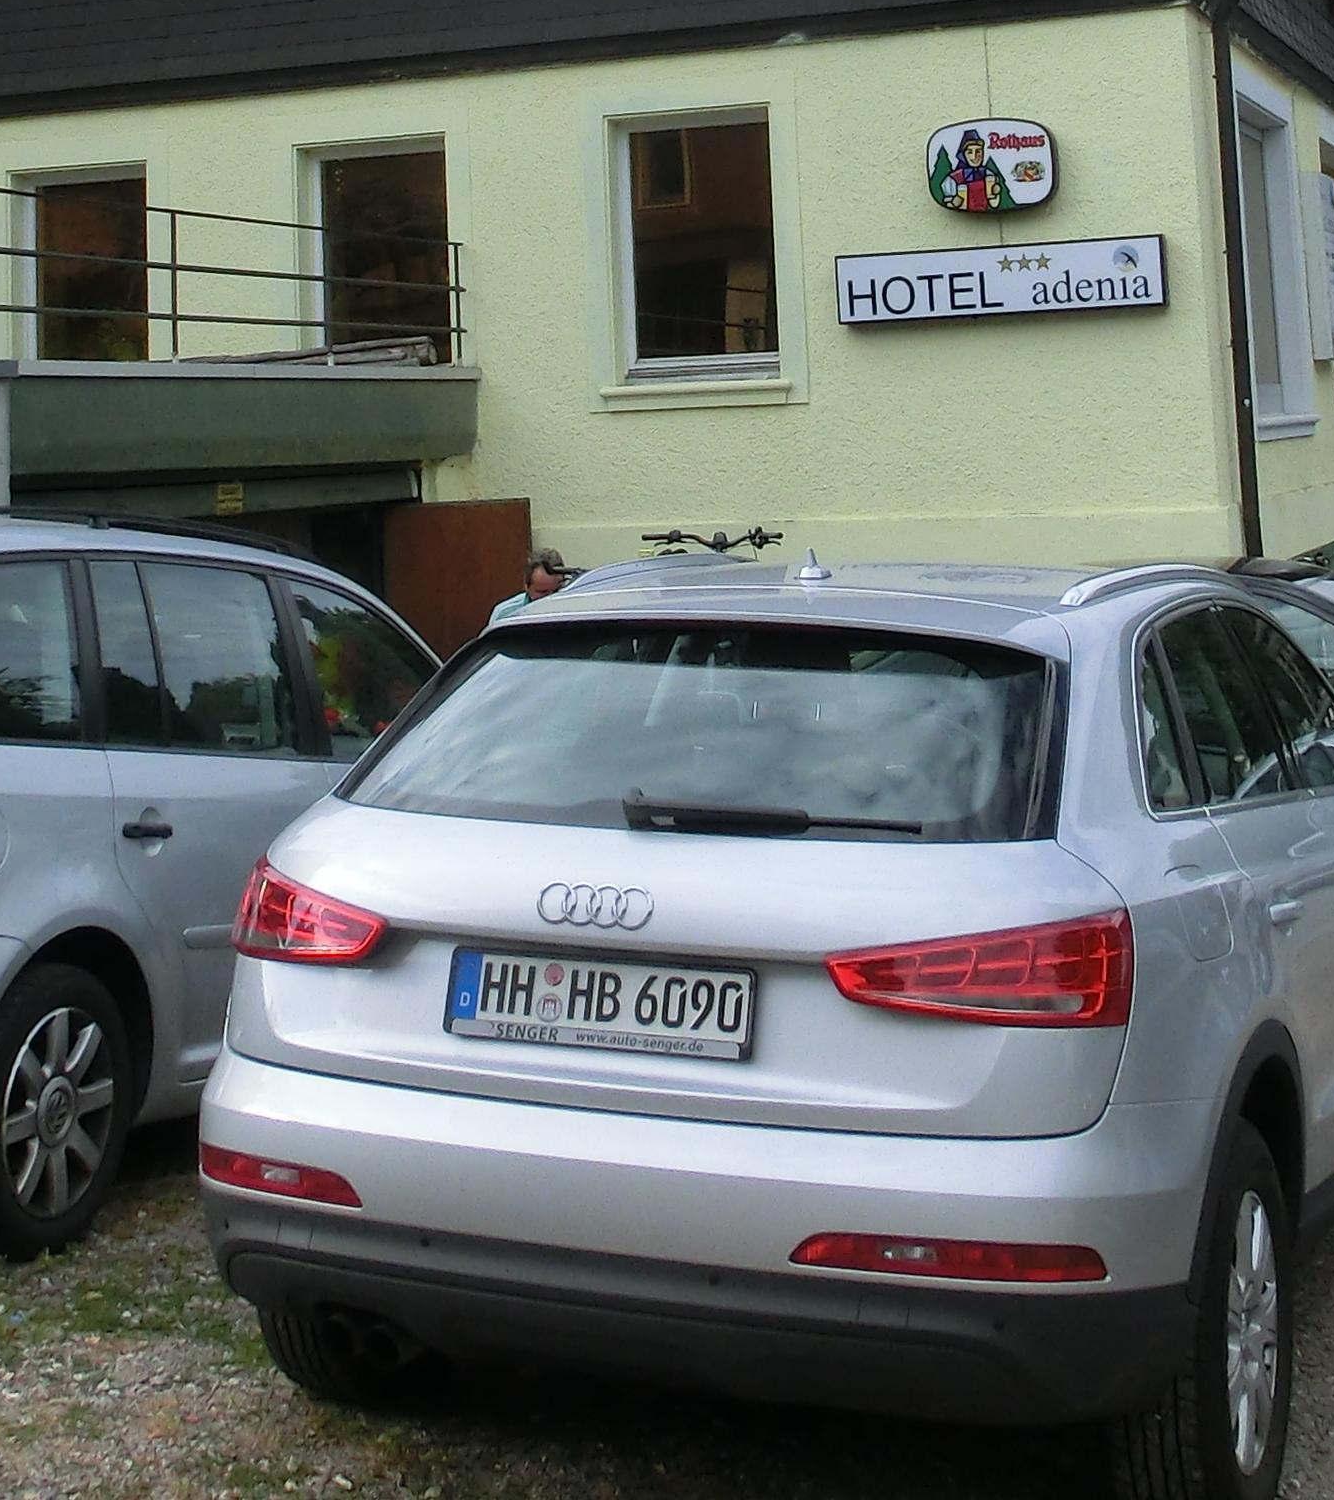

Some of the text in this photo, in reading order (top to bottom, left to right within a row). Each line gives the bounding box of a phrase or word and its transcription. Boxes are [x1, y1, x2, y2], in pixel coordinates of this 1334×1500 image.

[987, 131, 1046, 152] Rothaus
[847, 269, 1153, 317] HOTEL adenia
[459, 991, 471, 1007] D
[479, 961, 744, 1033] HH HB 6090
[575, 1031, 704, 1052] www.auto-senger.de
